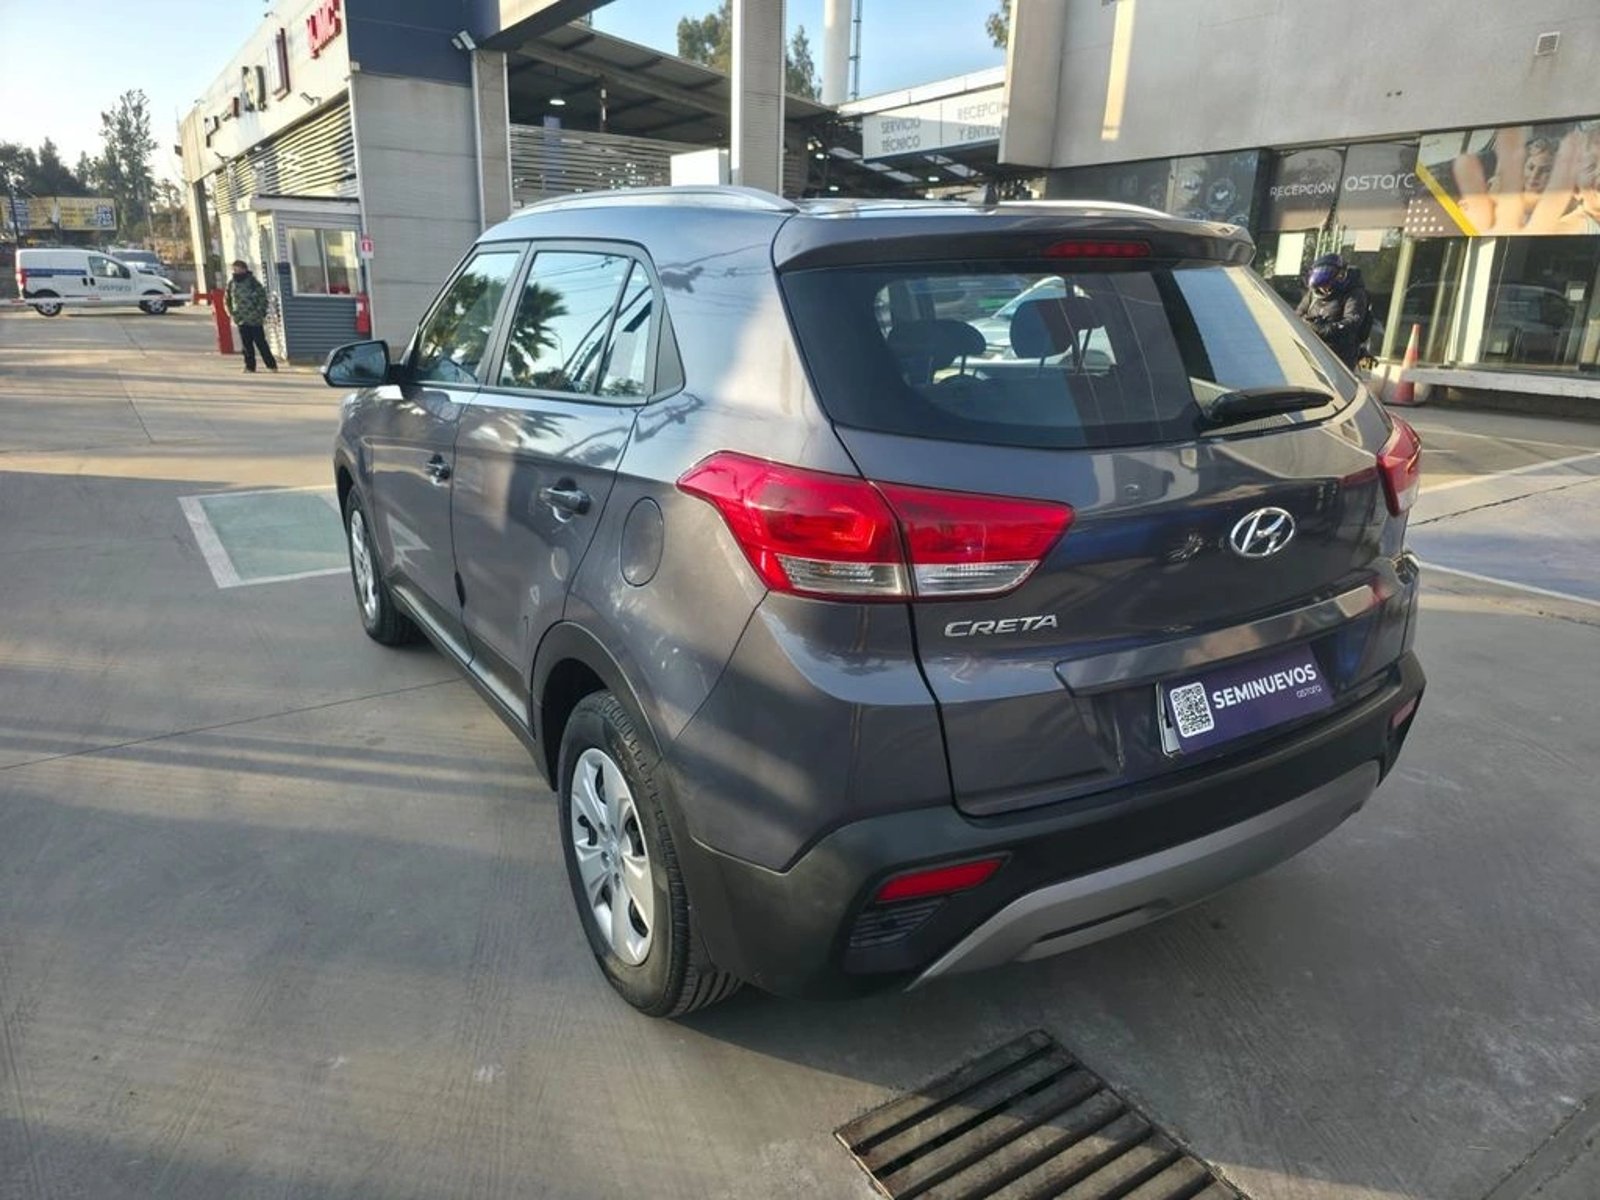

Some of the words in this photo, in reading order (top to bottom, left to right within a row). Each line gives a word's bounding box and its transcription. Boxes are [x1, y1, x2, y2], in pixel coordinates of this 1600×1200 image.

[881, 117, 921, 134] SERVICIO
[944, 614, 1058, 638] CRETA
[1212, 662, 1317, 711] SEMINUEVOS
